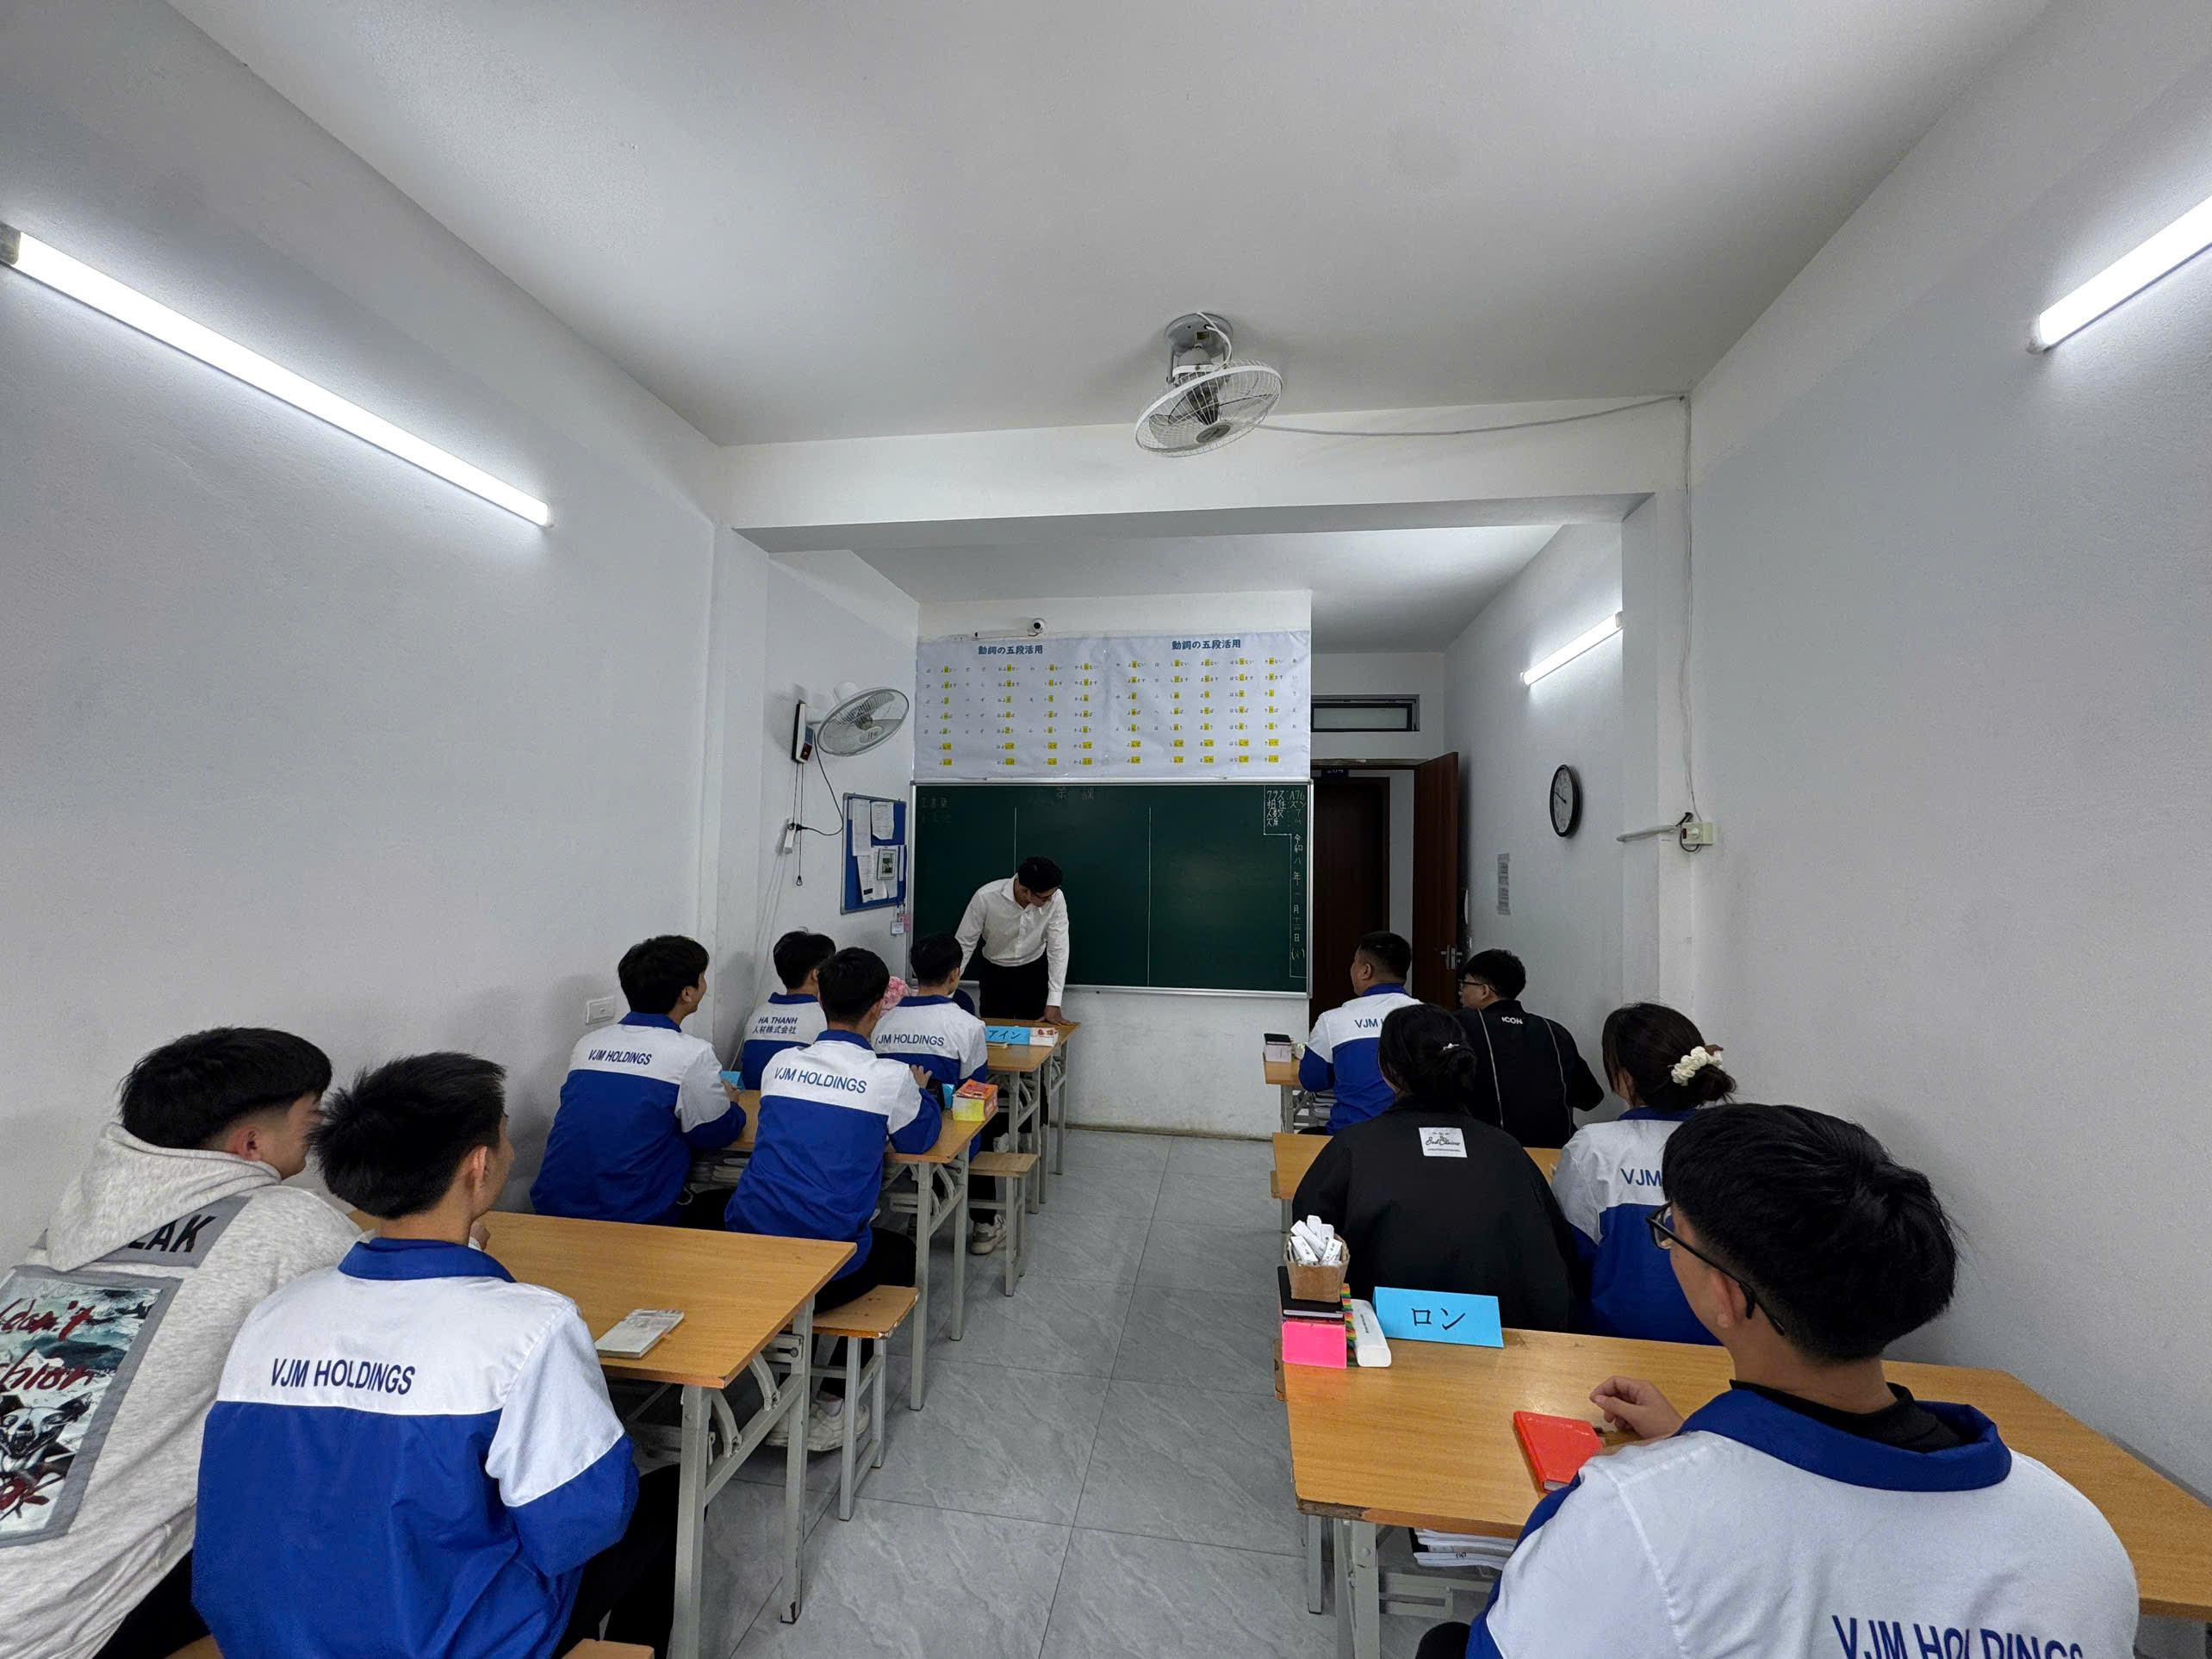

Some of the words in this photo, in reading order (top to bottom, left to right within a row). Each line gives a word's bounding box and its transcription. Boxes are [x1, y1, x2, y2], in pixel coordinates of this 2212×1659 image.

[978, 644, 1043, 655] 動詞の五段活用
[1171, 639, 1241, 650] 動詞の五段活用
[1354, 1018, 1378, 1028] VJM
[893, 1034, 945, 1047] HOLDINGS
[587, 1049, 606, 1061] VJM
[605, 1050, 652, 1066] HOLDINGS
[774, 1067, 798, 1081] VJM
[798, 1070, 867, 1094] HOLDINGS
[1620, 1168, 1662, 1187] VJM
[1411, 1308, 1466, 1331] ロン
[270, 1358, 311, 1388] VJM
[313, 1359, 416, 1395] HOLDINGS
[1831, 1615, 1908, 1659] VJM
